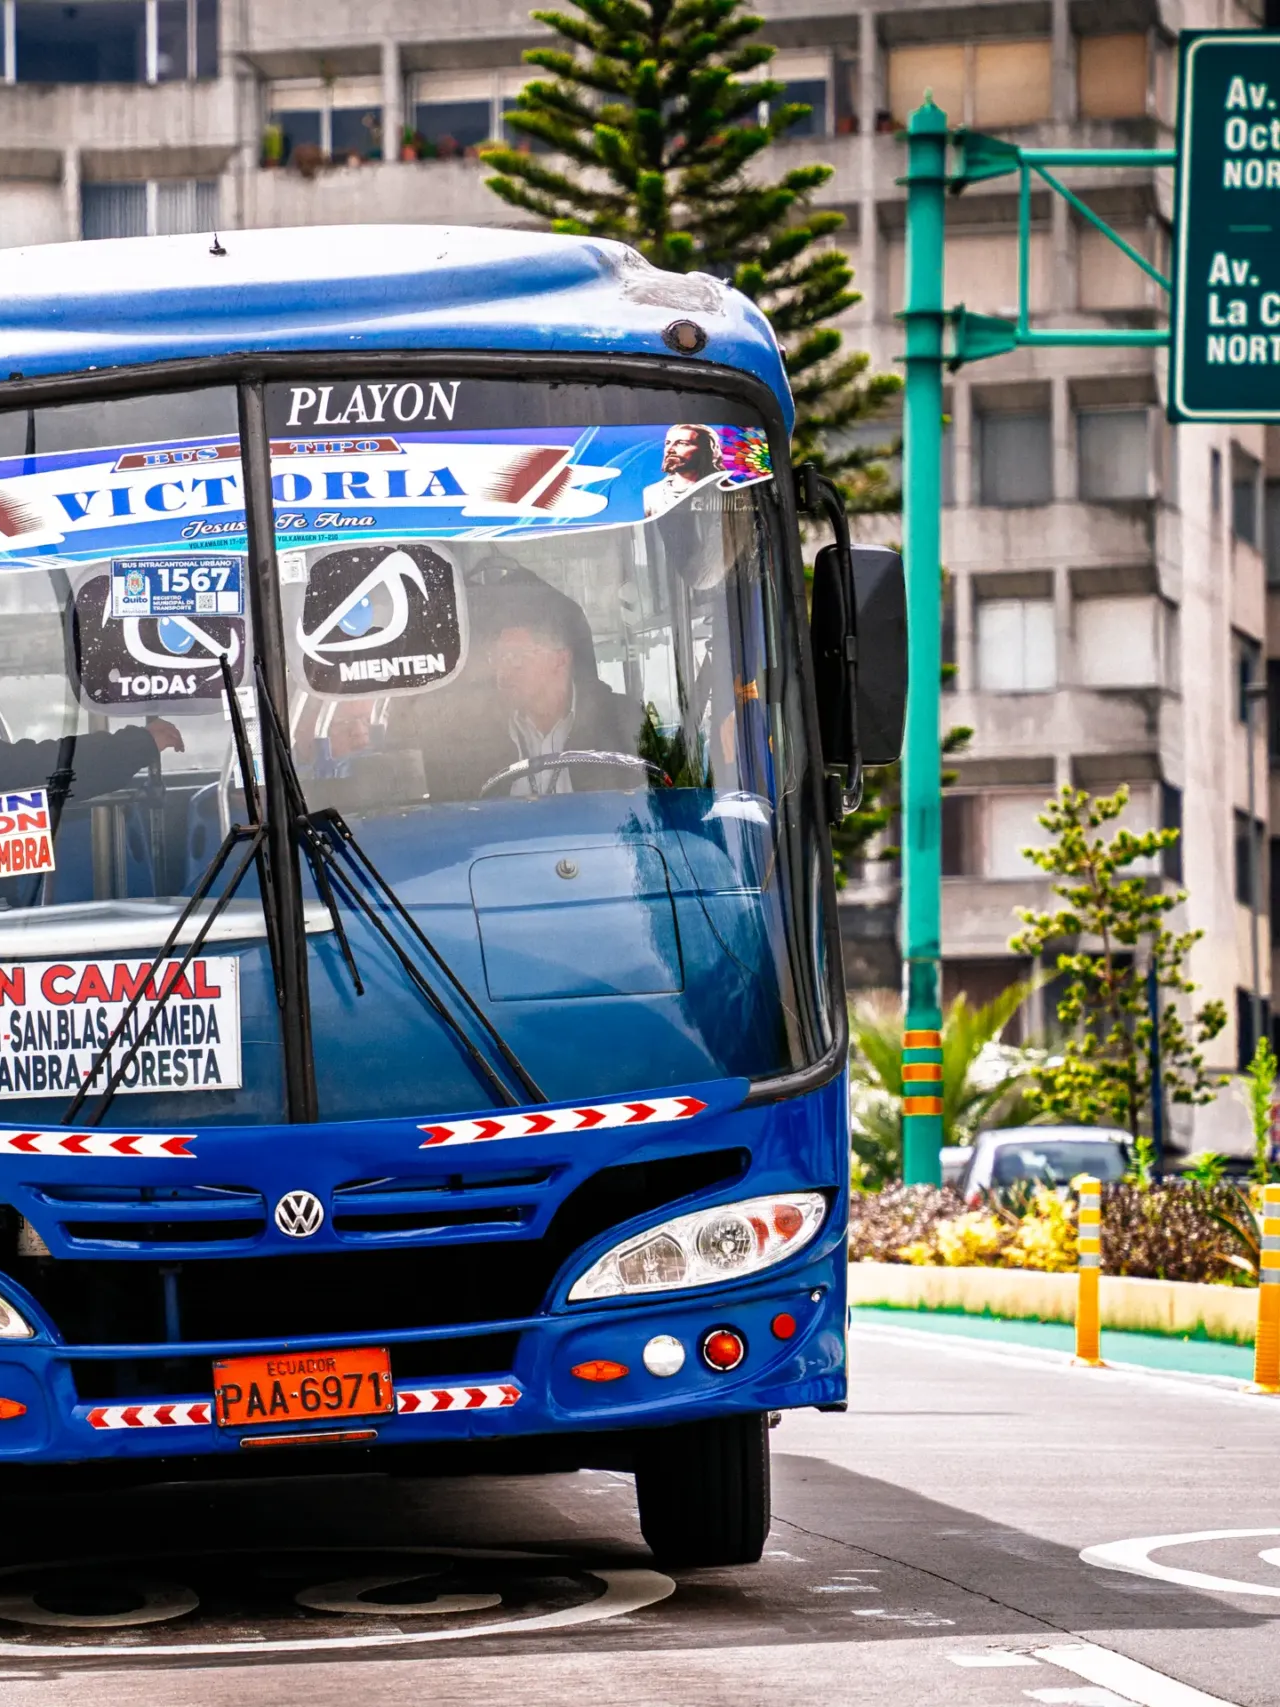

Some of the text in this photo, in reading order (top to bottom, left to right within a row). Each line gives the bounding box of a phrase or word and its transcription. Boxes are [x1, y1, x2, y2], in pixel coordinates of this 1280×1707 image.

[1225, 75, 1277, 109] Av.
[1208, 252, 1260, 287] Av.
[1208, 292, 1248, 326] La
[286, 381, 461, 426] PLAYON
[143, 440, 380, 466] BUS TIPO
[53, 466, 470, 522] VICTORIA
[181, 512, 376, 540] Jesus Te Ama
[158, 567, 231, 592] 1567
[122, 595, 148, 604] Quito
[340, 653, 446, 682] MIENTEN
[118, 674, 197, 697] TODAS
[41, 960, 221, 1006] CAMAL
[267, 1357, 337, 1376] ECUADOR
[220, 1371, 384, 1419] PAA-6971
